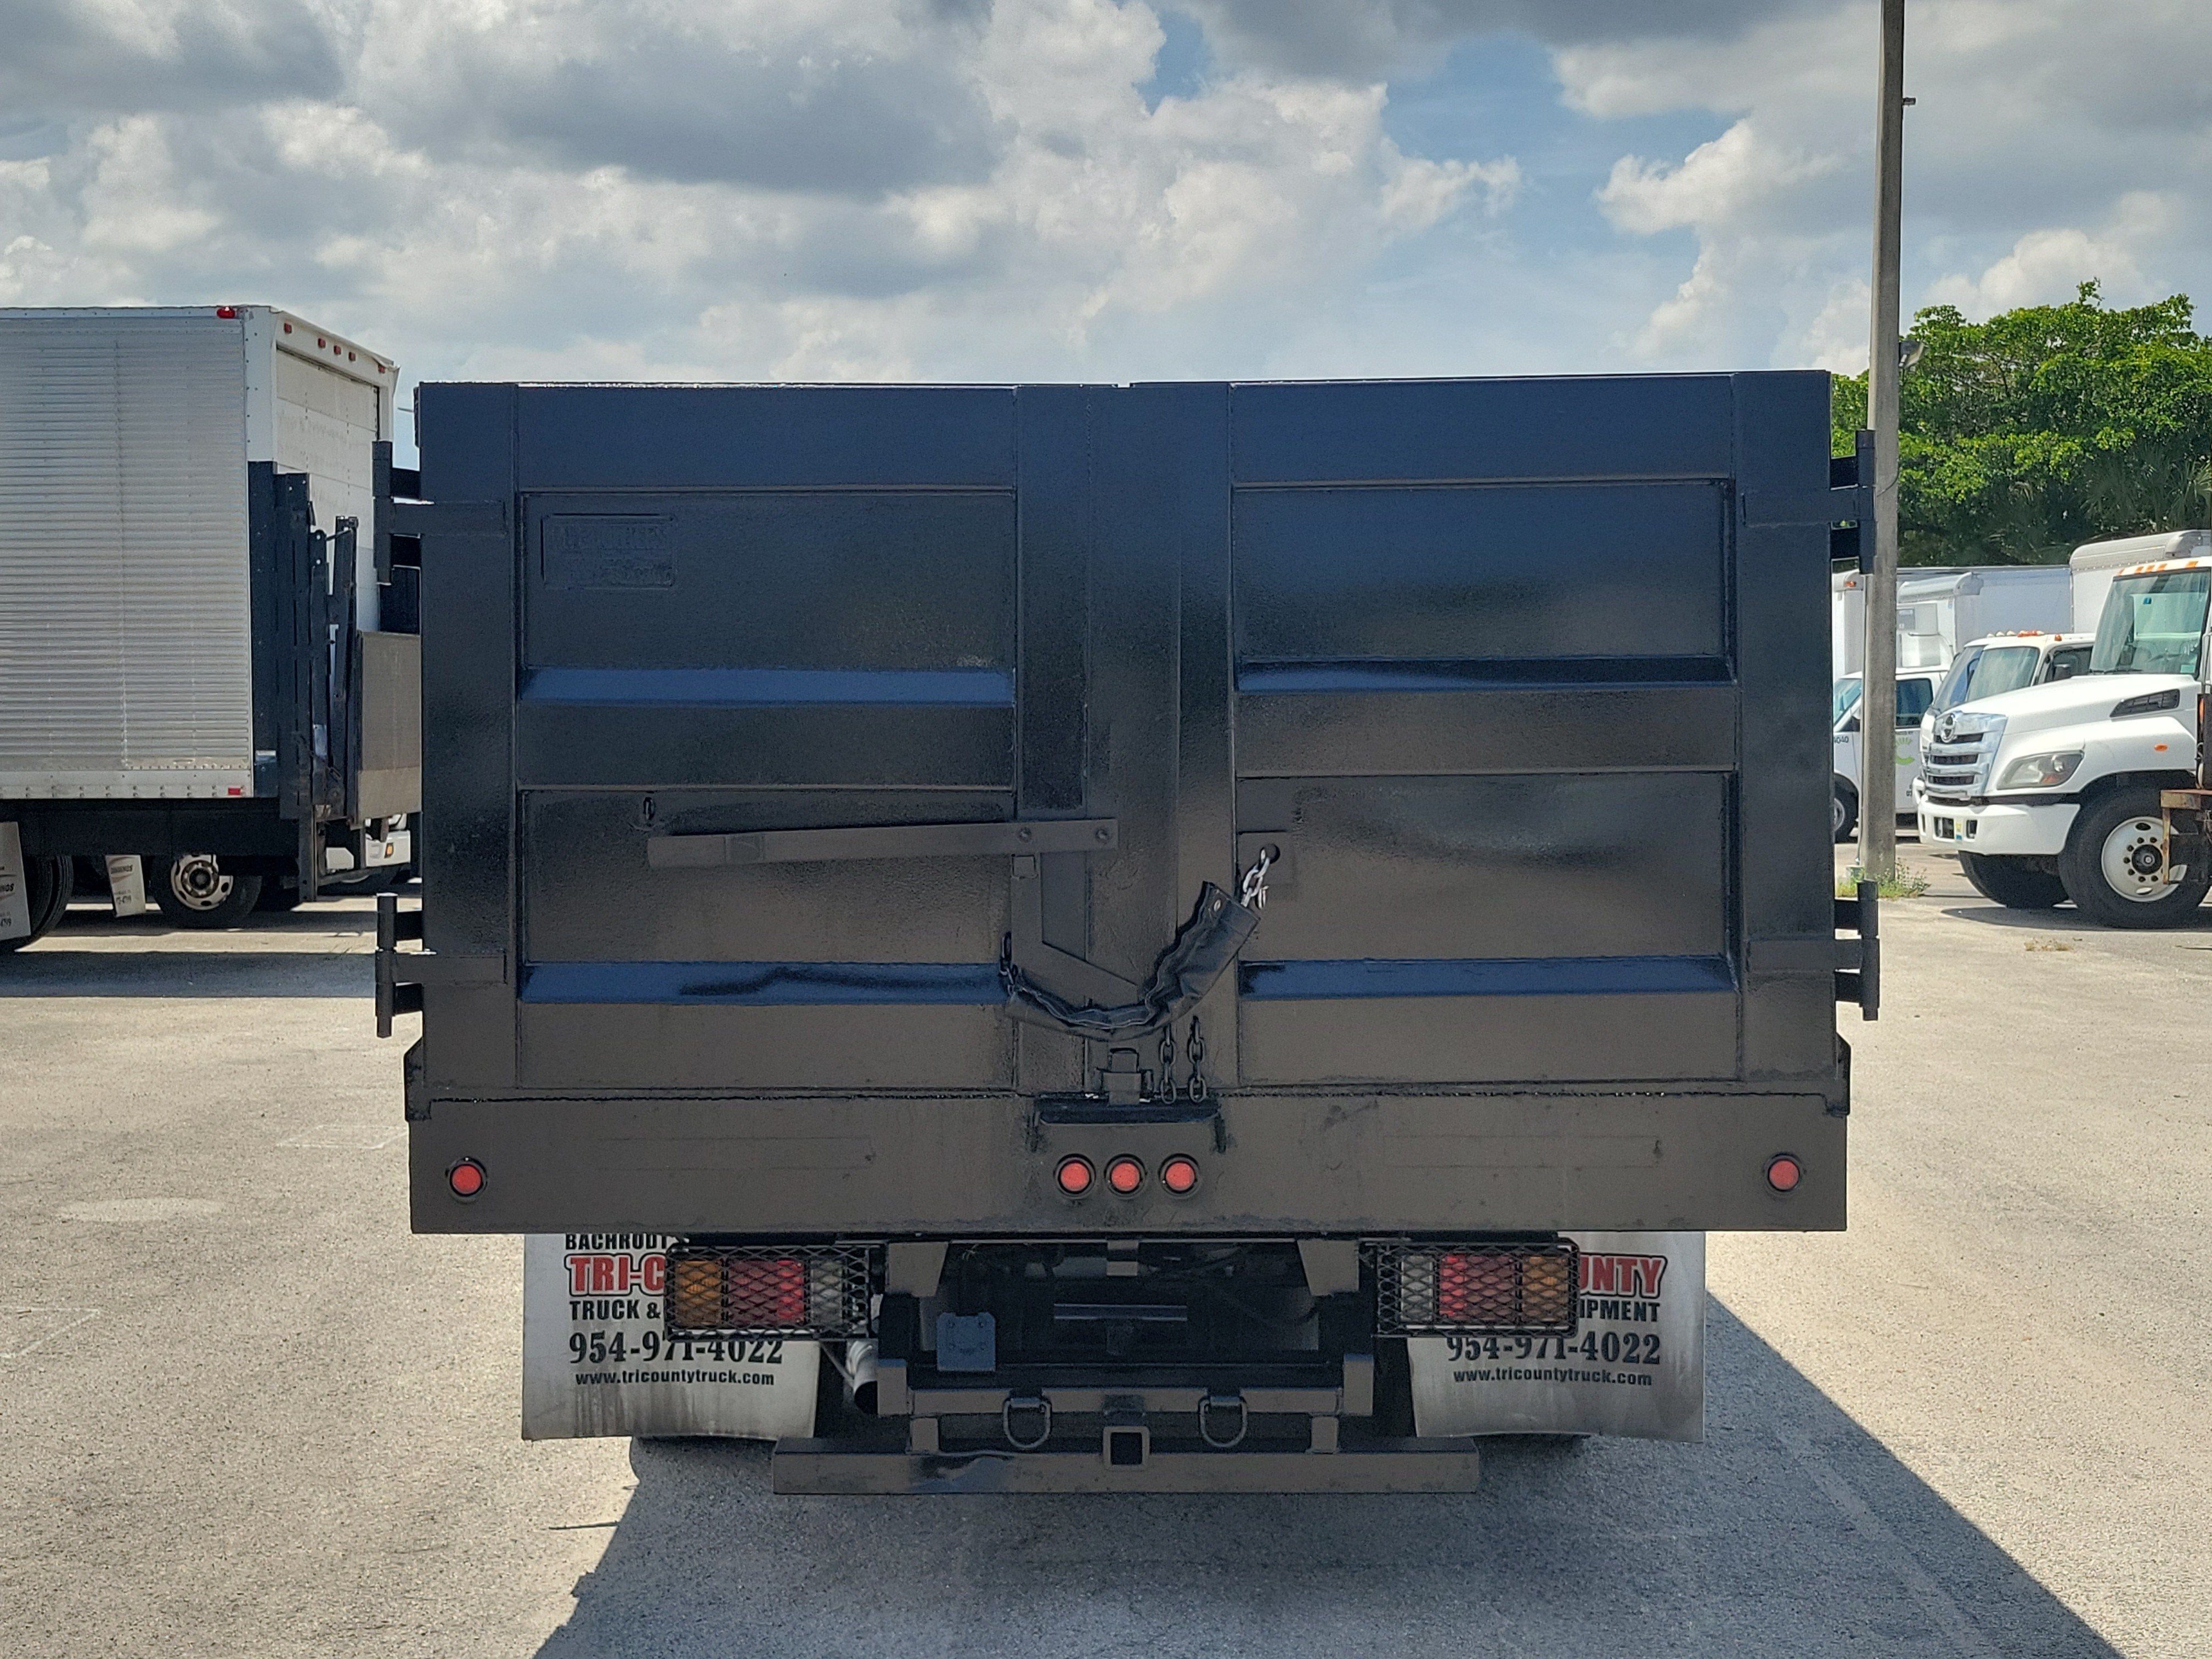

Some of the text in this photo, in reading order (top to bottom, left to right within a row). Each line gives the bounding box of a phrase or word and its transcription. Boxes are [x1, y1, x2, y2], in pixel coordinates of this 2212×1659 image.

[569, 1300, 661, 1321] TRUCK &
[569, 1330, 783, 1364] 954-971-4022
[1446, 1331, 1661, 1365] 954-971-4022
[575, 1369, 775, 1385] www.tricountytruck.com
[1453, 1367, 1652, 1386] www.tricountytruck.com
